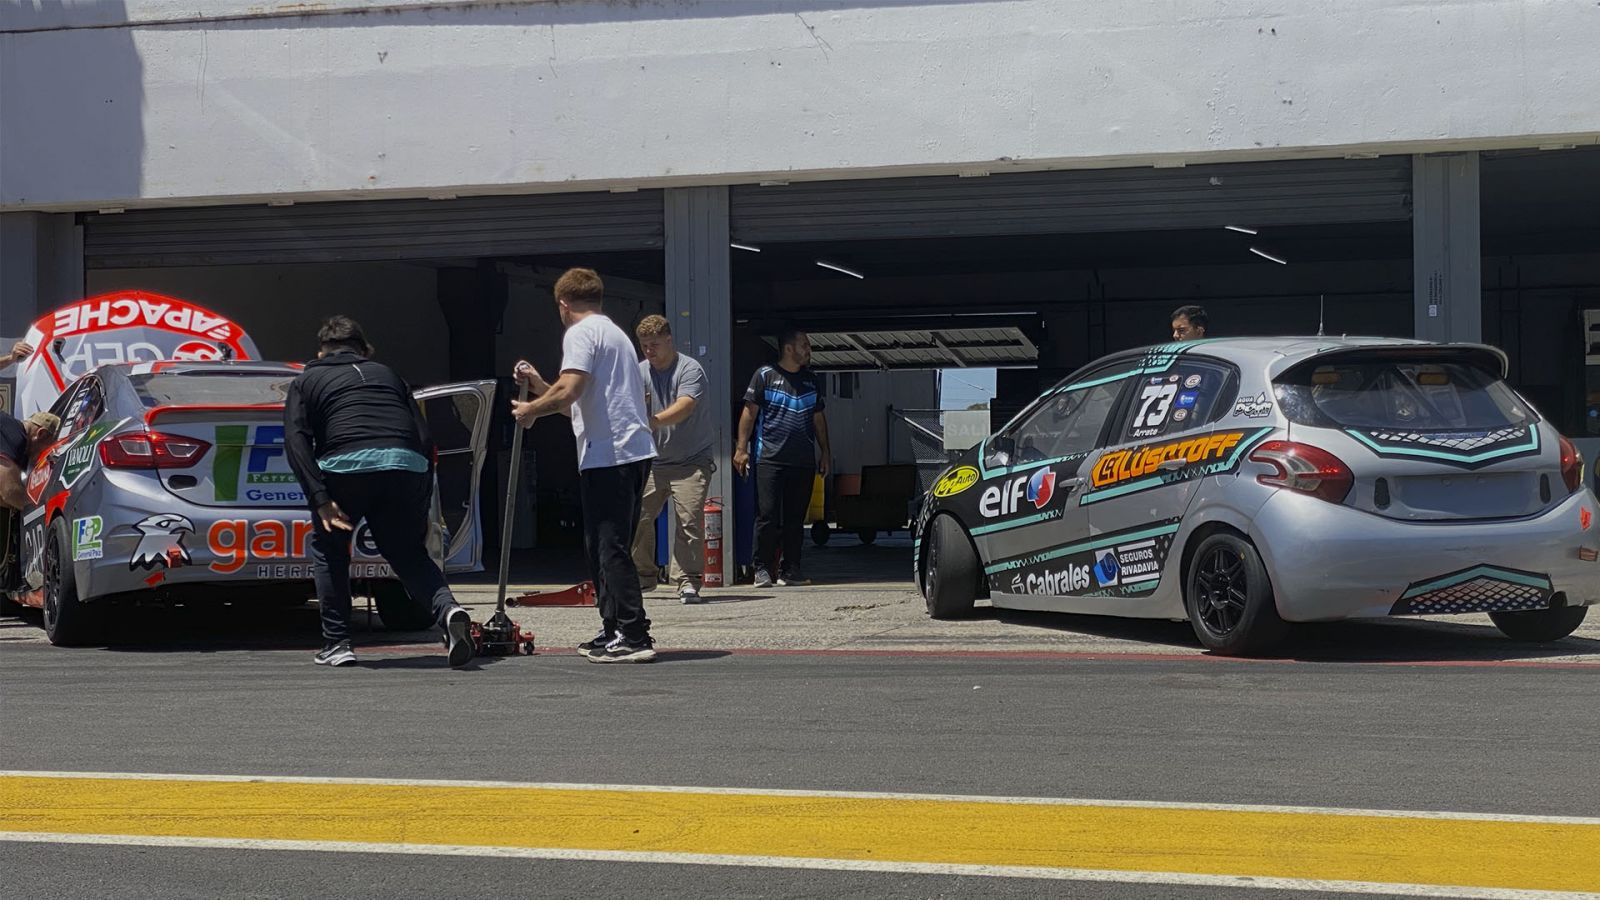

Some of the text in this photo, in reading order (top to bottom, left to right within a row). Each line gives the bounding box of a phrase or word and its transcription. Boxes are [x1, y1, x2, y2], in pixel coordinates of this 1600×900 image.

[53, 299, 230, 340] APACHE
[1133, 384, 1178, 428] 73
[946, 424, 988, 437] SALI
[252, 473, 297, 483] Ferre
[246, 489, 304, 501] Gener
[979, 475, 1028, 518] elf
[1119, 549, 1153, 564] SEGUROS
[1120, 560, 1160, 577] RIVADAVIA
[1026, 563, 1090, 597] Cabrales
